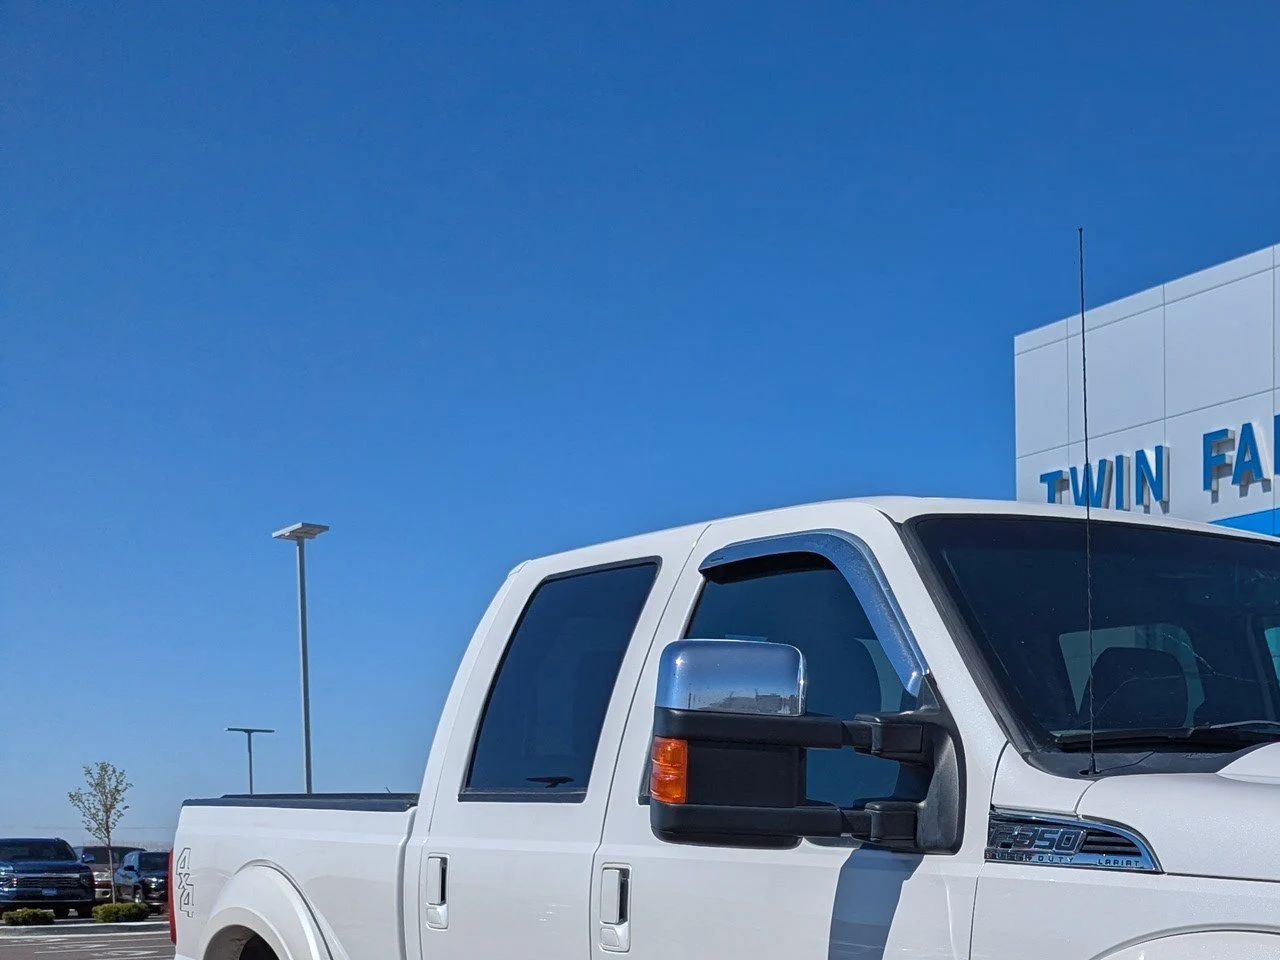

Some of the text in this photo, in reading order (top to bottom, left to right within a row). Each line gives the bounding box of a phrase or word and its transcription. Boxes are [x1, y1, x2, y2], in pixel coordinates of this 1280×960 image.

[1040, 445, 1170, 511] TWIN
[1037, 854, 1075, 864] DUTY
[1097, 858, 1140, 867] LARIAT
